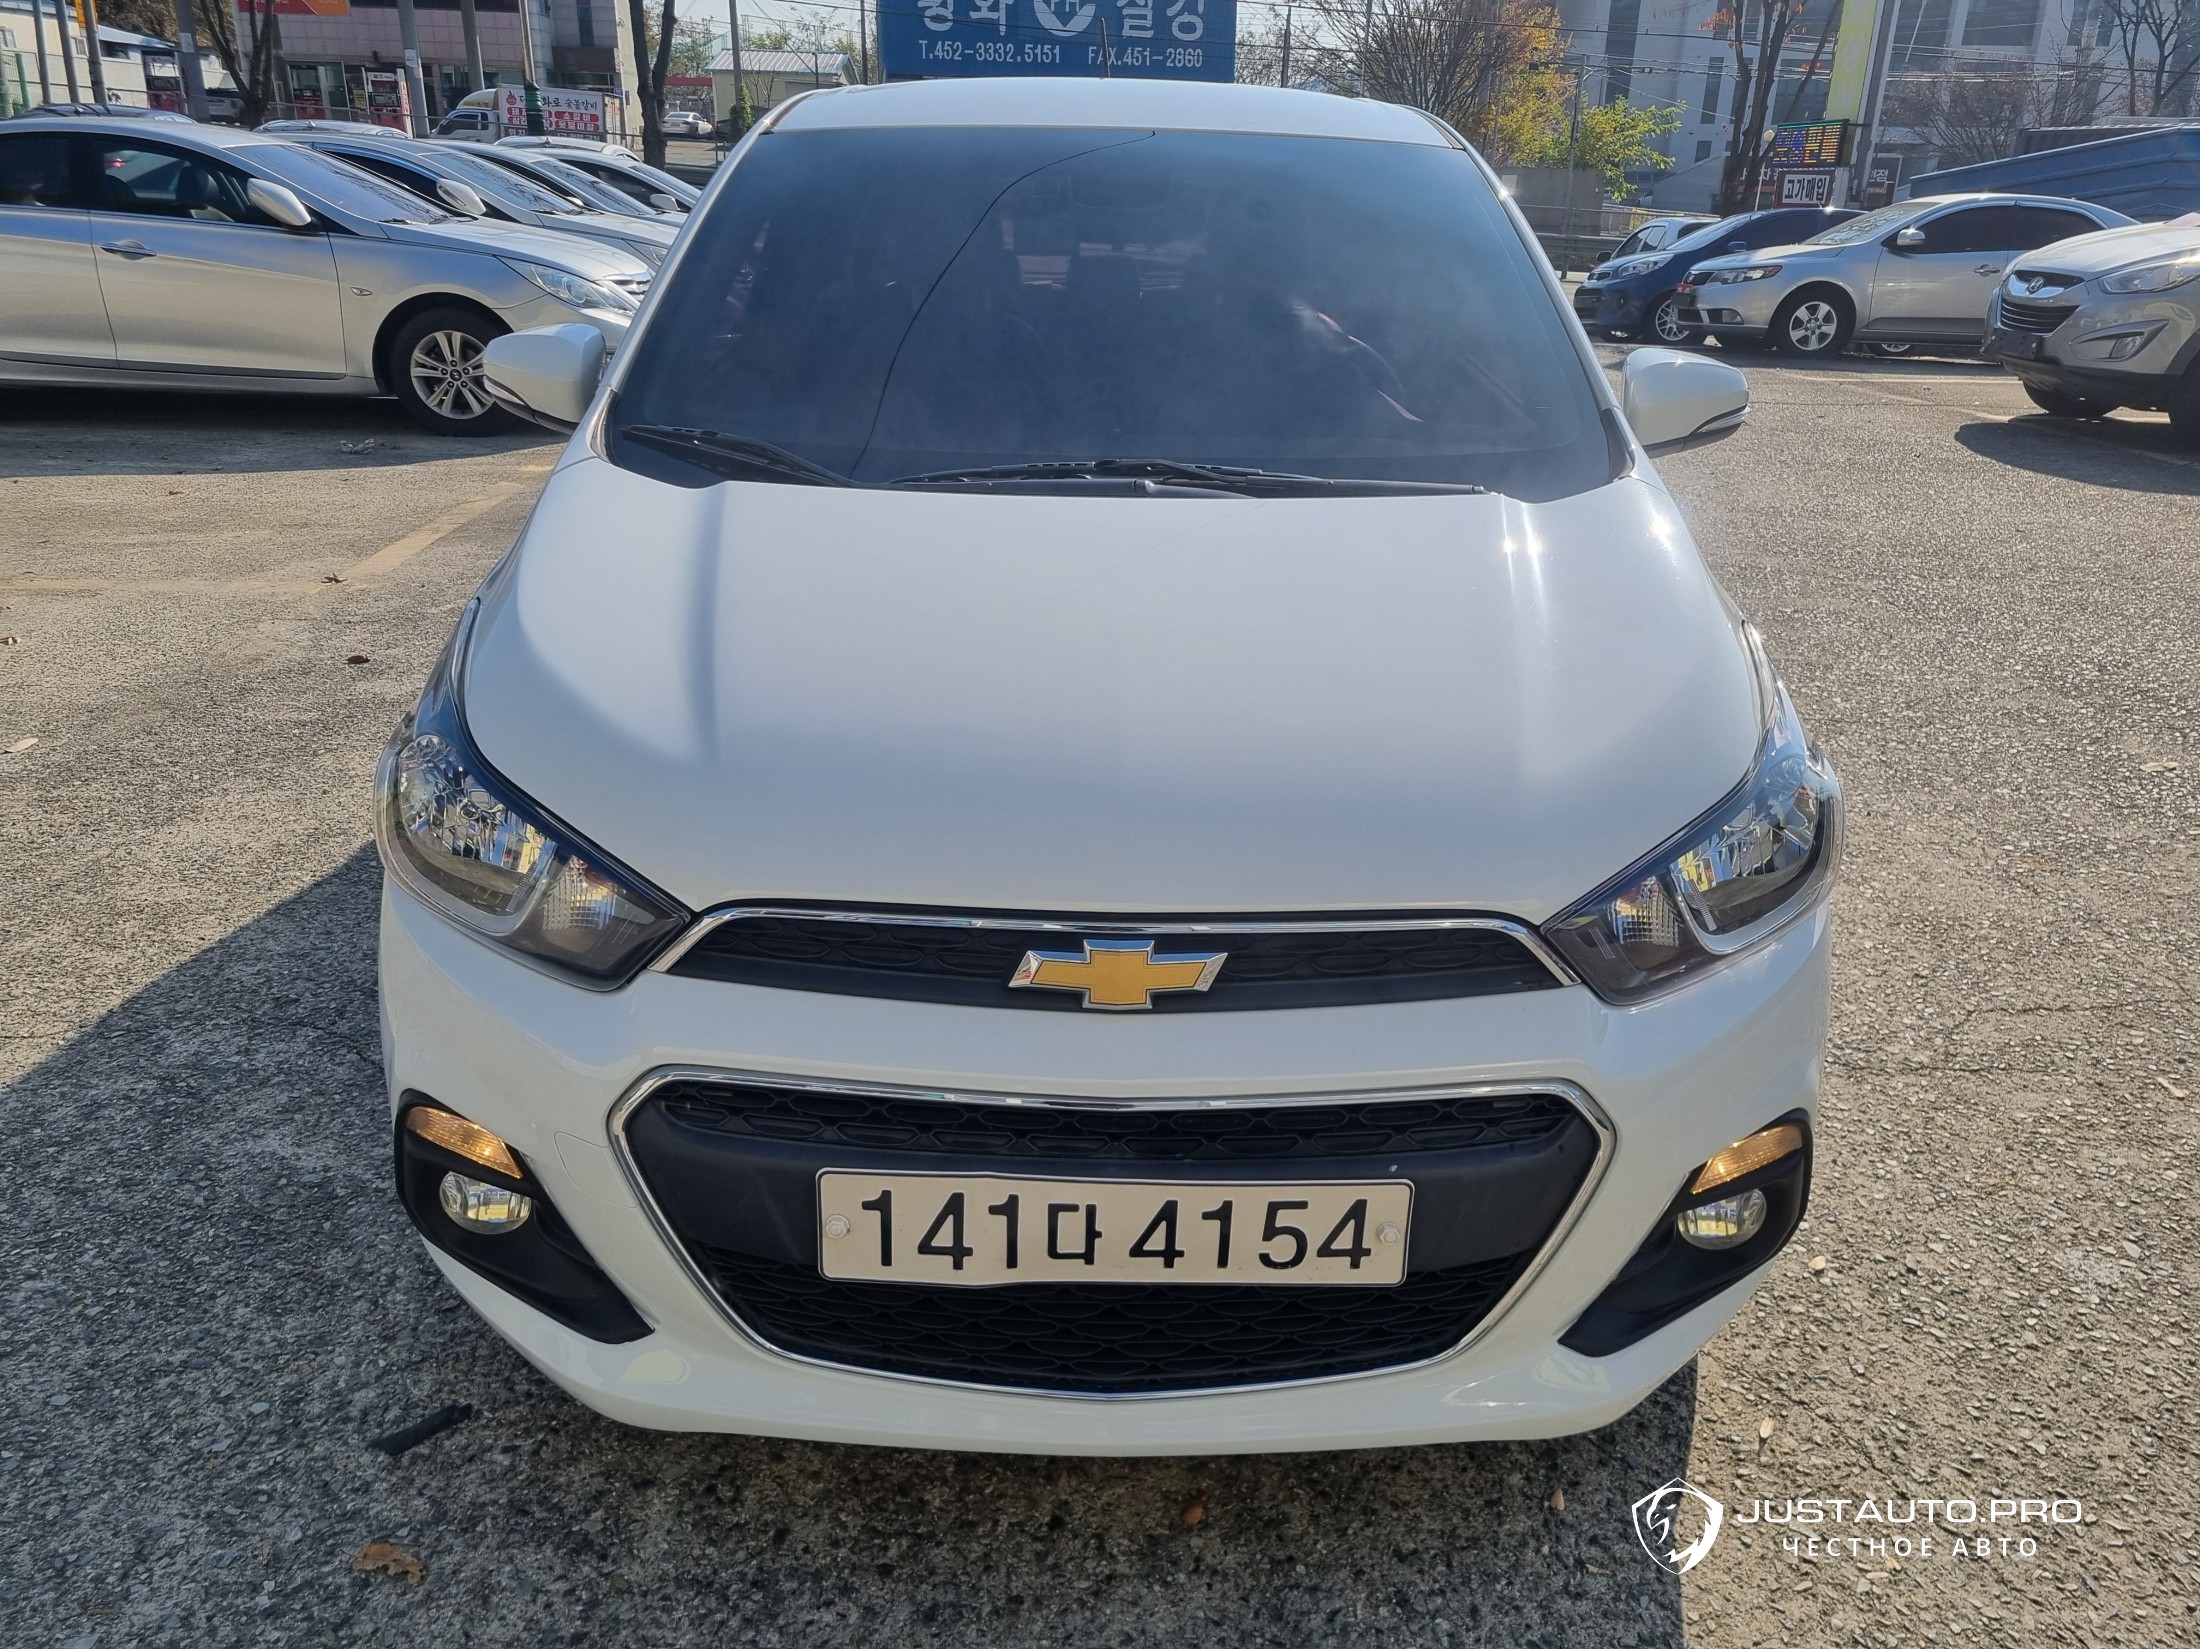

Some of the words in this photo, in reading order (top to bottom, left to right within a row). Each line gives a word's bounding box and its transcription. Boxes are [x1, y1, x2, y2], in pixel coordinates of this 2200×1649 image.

[918, 40, 1060, 64] T.452-3332.5151
[1087, 46, 1203, 68] FAX.451-2860
[1784, 177, 1828, 201] 고가매입
